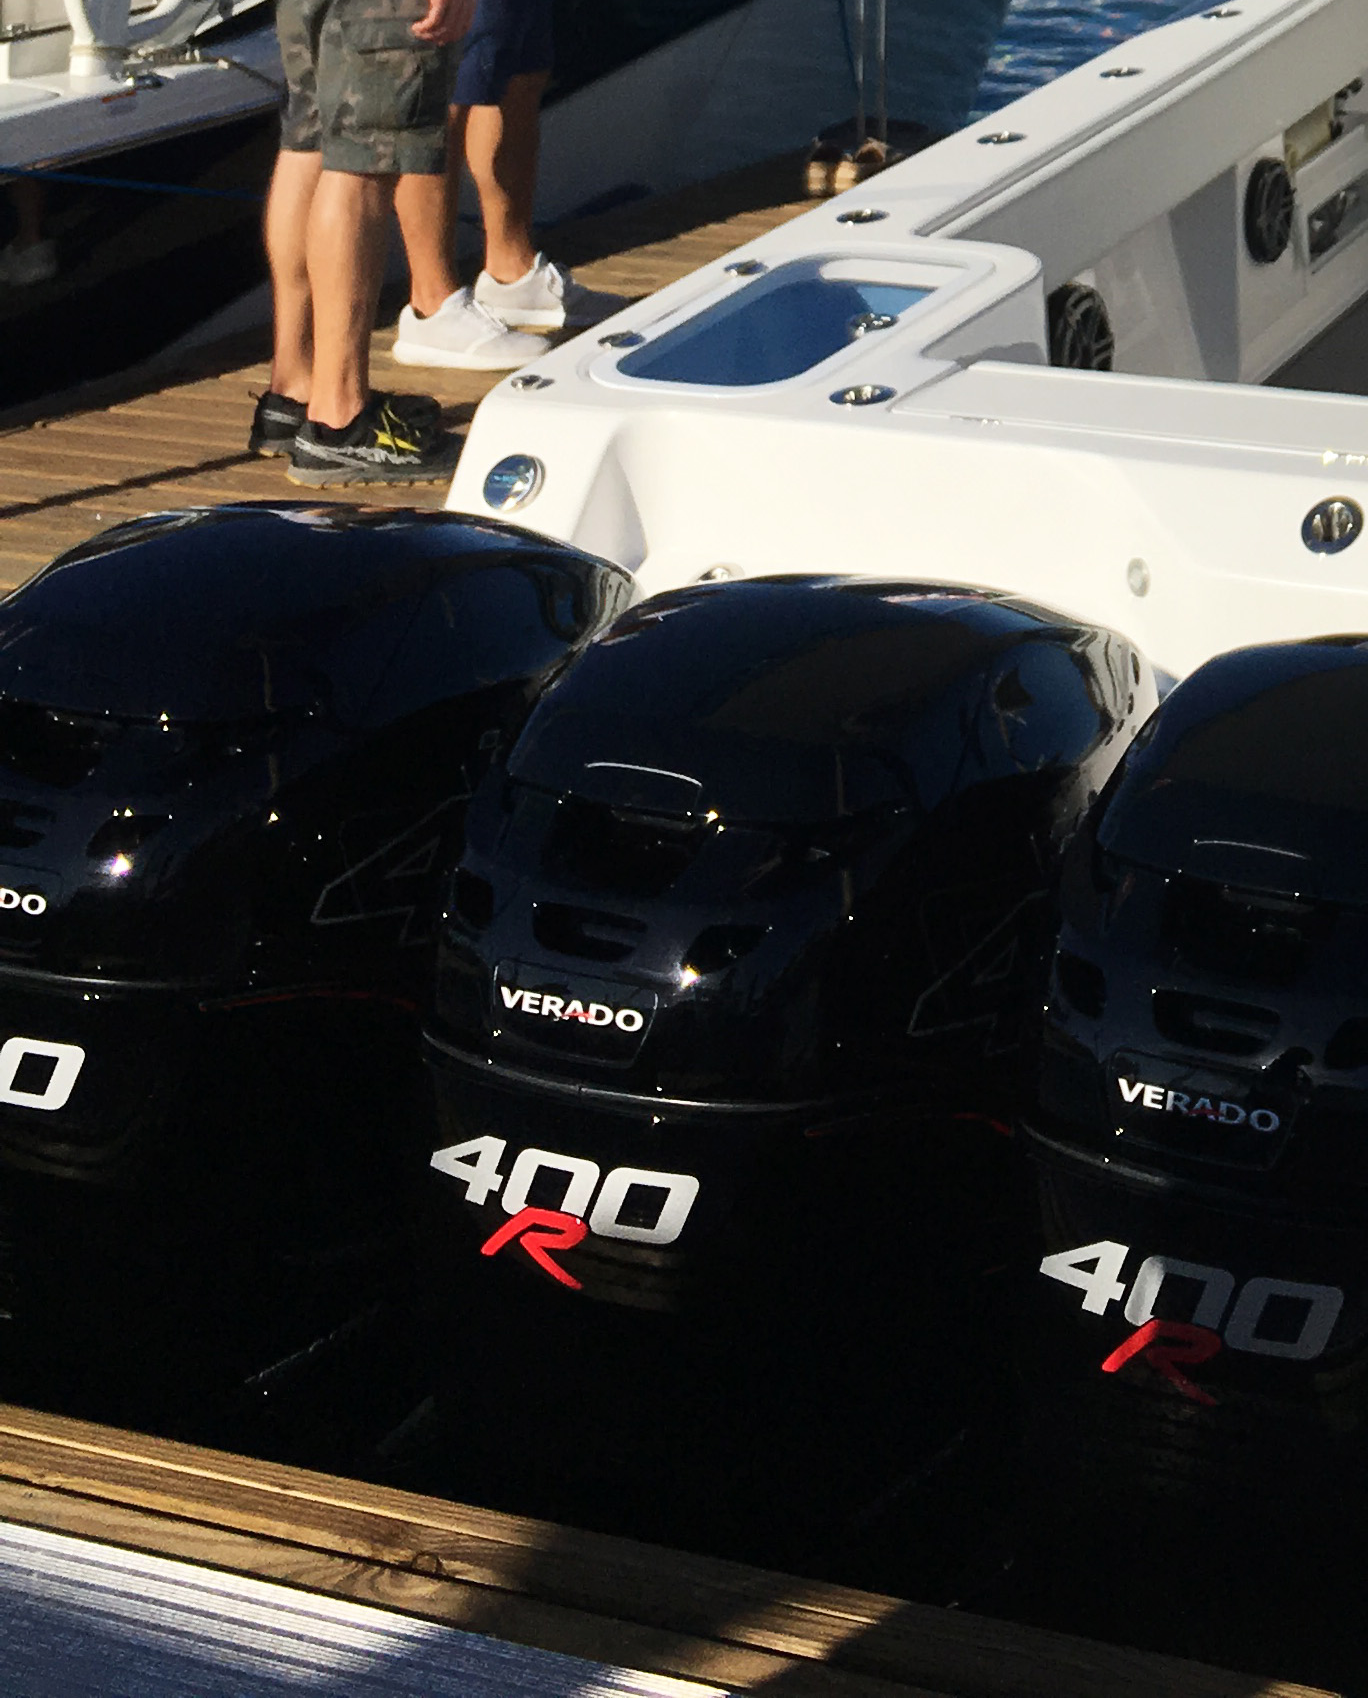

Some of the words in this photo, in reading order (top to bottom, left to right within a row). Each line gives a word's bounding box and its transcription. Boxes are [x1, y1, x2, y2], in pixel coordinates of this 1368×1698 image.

[0, 887, 47, 915] DO
[500, 986, 644, 1032] VERADO
[1117, 1077, 1280, 1133] VERADO
[429, 1135, 700, 1244] 400
[479, 1205, 589, 1290] R
[1038, 1239, 1345, 1362] 400
[1101, 1318, 1223, 1406] R
